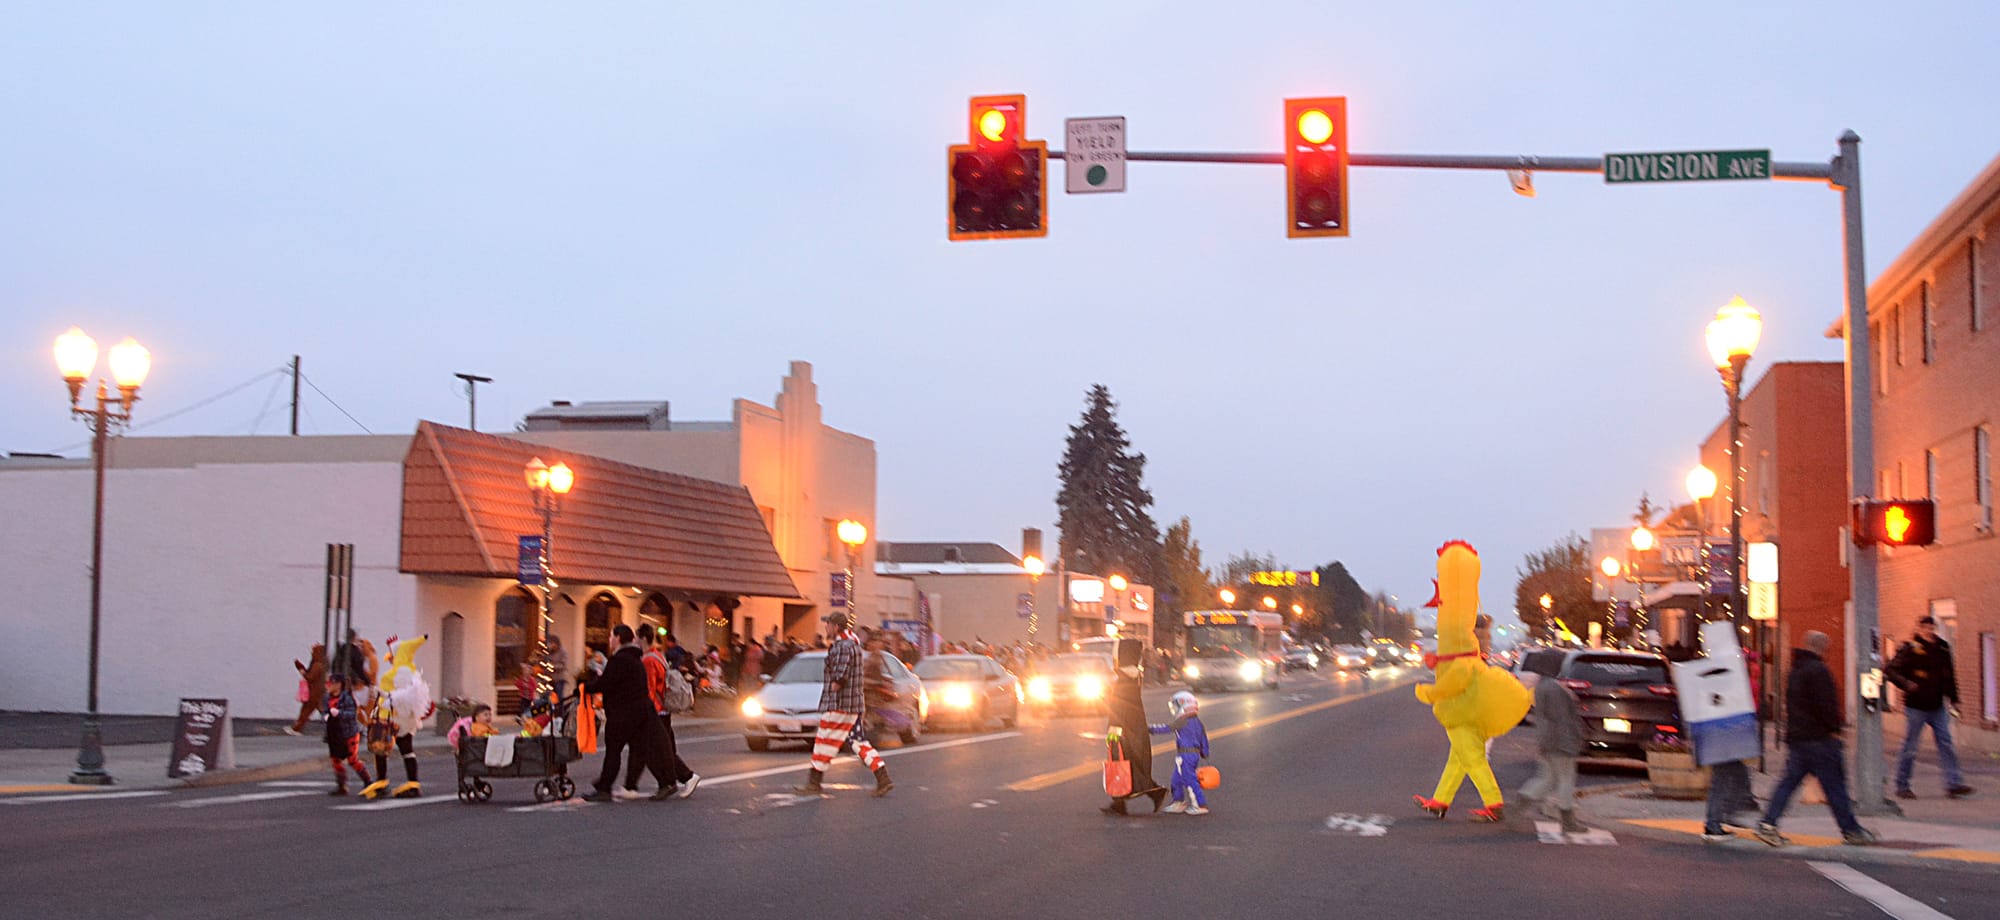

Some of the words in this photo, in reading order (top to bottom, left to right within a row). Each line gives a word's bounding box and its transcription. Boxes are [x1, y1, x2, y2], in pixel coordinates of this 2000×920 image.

[1099, 122, 1121, 133] TURN
[1076, 135, 1116, 149] YIELD
[1070, 151, 1084, 162] ON
[1089, 151, 1121, 162] GREEN
[1609, 153, 1719, 181] DIVISION
[1728, 157, 1766, 177] AVE
